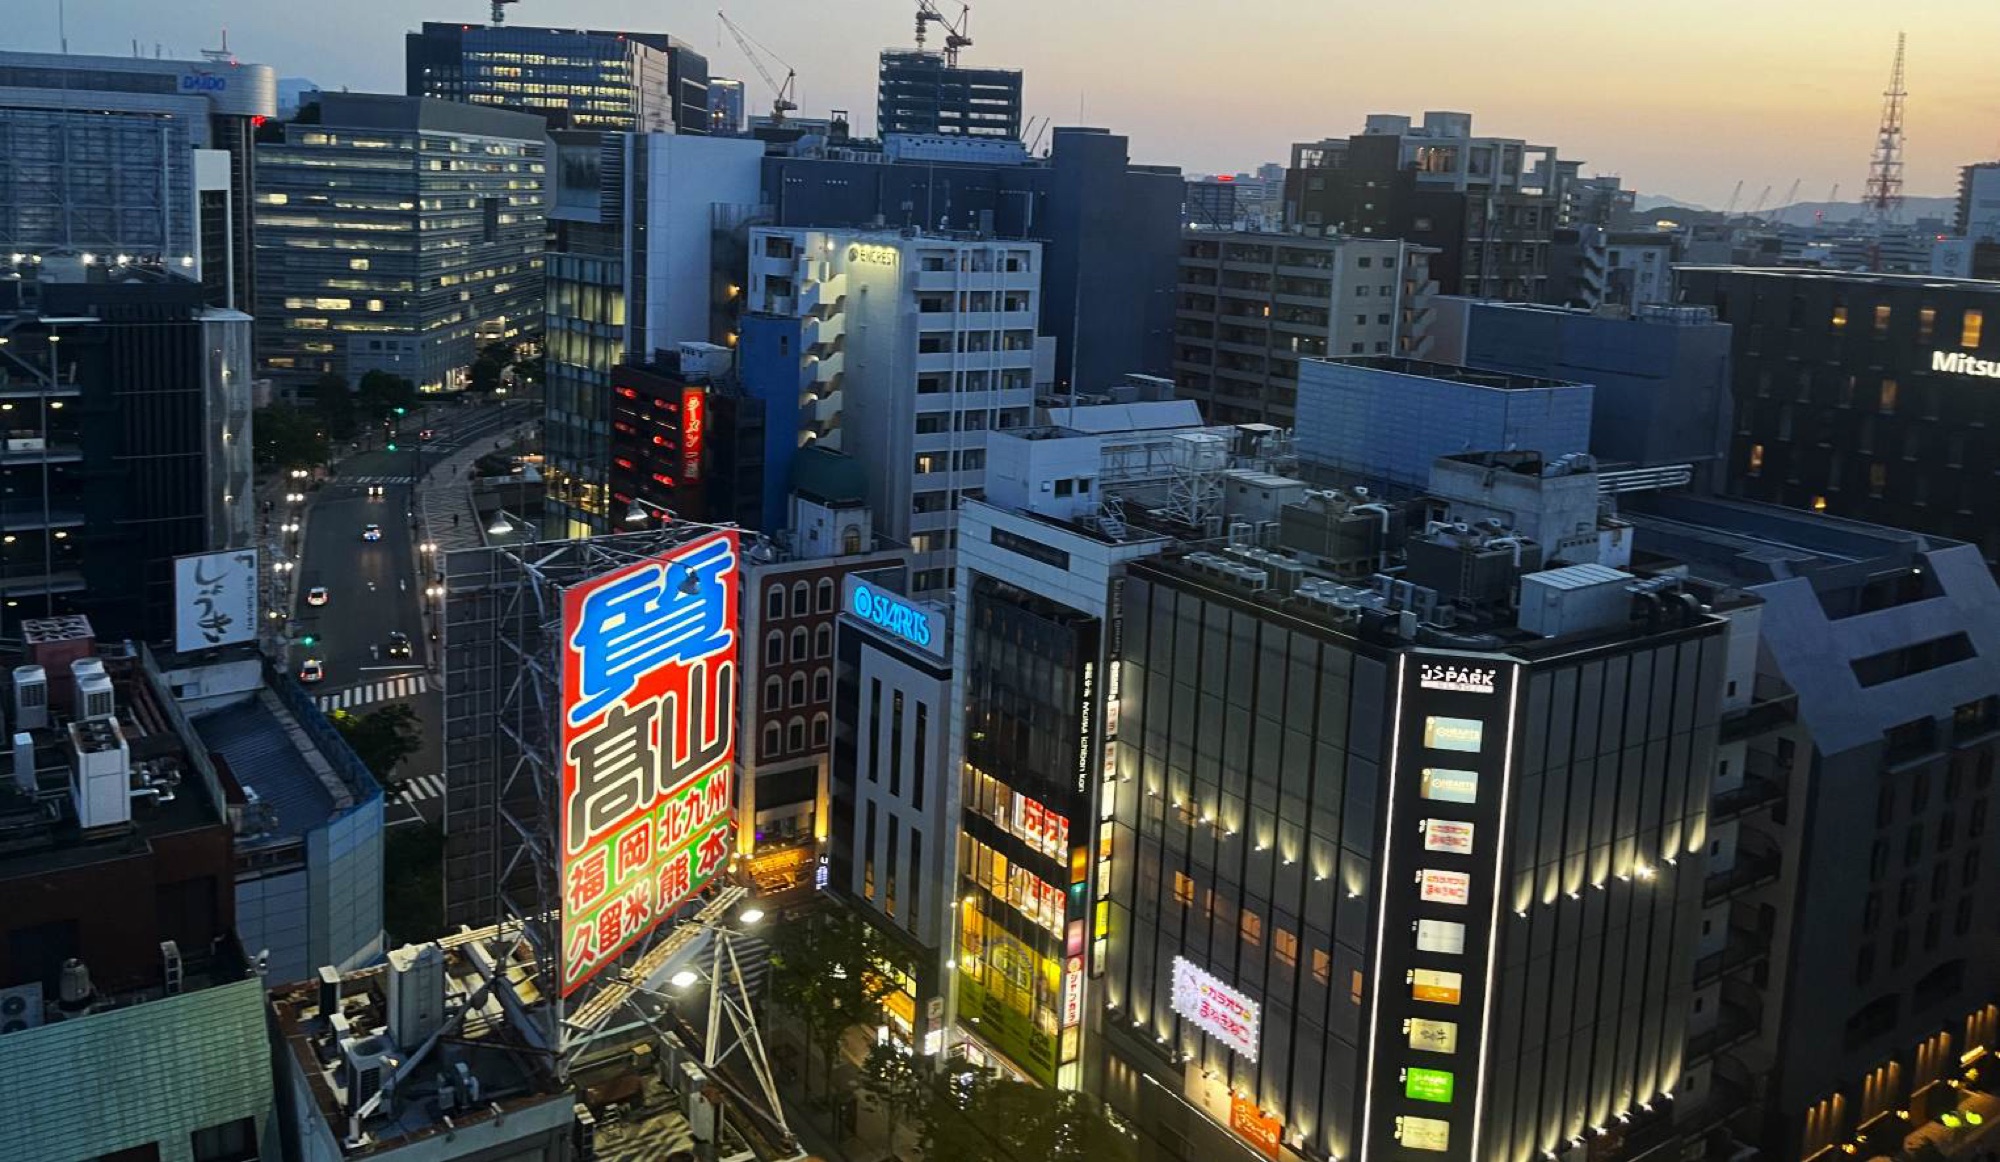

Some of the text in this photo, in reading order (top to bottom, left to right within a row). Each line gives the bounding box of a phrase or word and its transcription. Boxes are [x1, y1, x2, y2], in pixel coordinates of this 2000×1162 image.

[1931, 350, 2000, 379] Mitsu
[872, 595, 931, 646] STARTS
[570, 768, 727, 912] 福岡 北九州
[567, 829, 728, 980] 久留米 熊本
